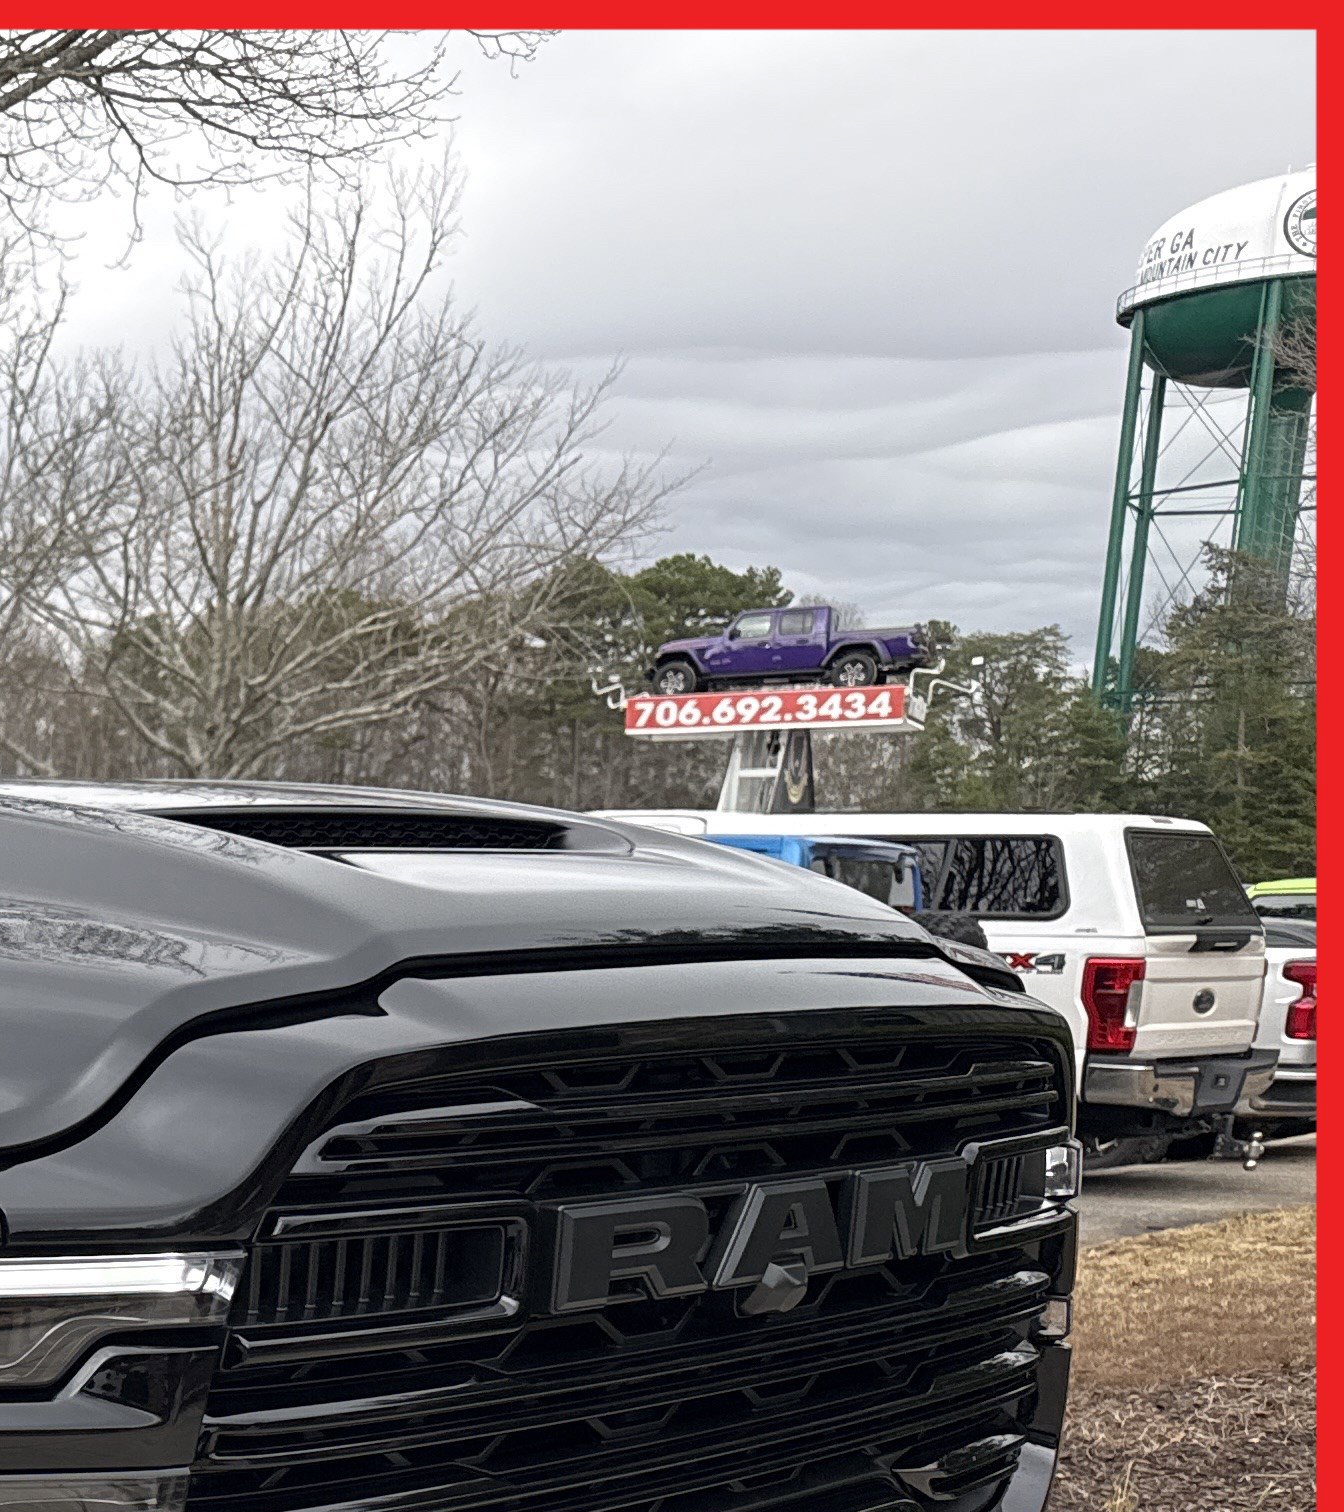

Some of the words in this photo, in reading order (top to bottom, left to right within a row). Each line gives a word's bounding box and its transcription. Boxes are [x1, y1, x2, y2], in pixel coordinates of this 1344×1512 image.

[1170, 227, 1195, 254] GA
[1202, 240, 1249, 266] CITY
[634, 691, 892, 728] 706.692.3434
[996, 952, 1066, 970] X4
[551, 1156, 969, 1315] RAM
